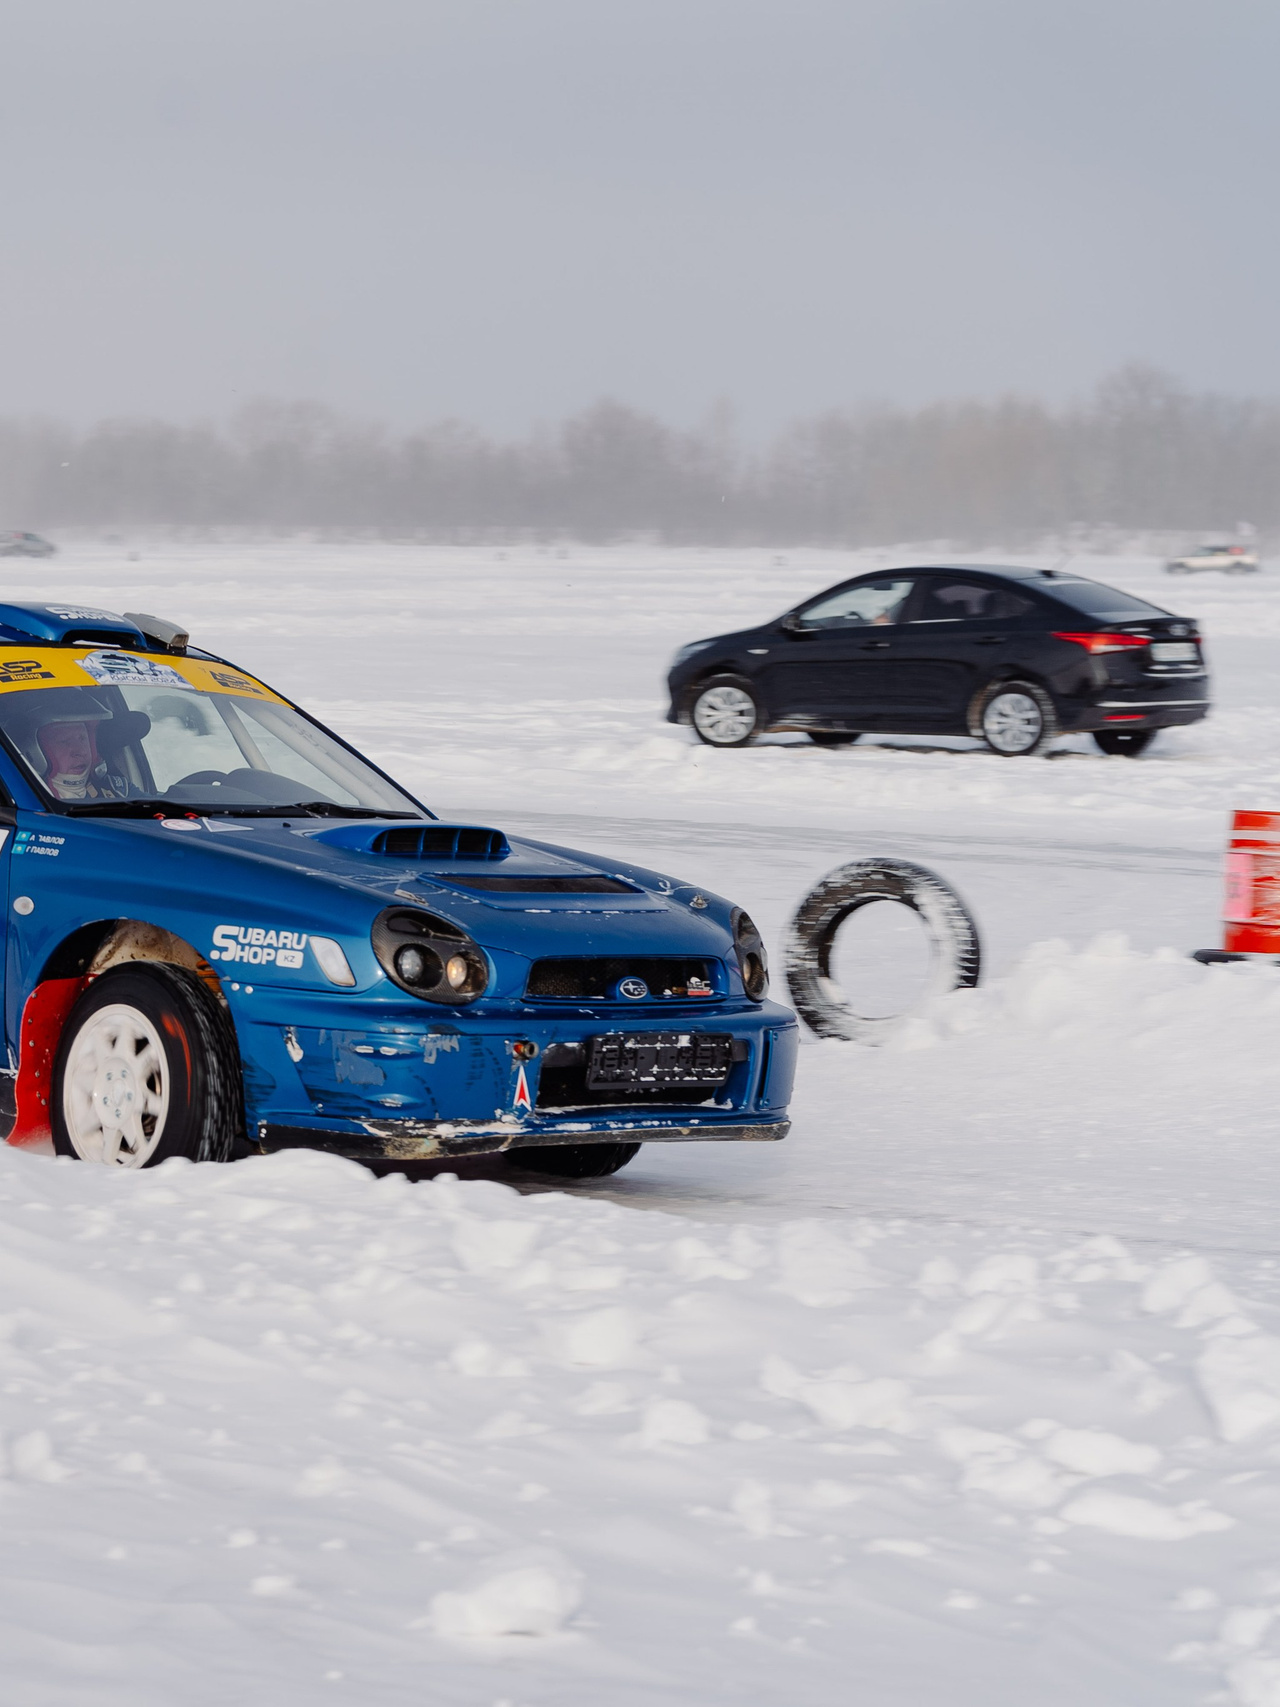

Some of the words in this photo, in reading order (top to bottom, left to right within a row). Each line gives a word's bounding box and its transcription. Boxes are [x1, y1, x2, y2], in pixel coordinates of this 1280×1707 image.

[10, 672, 42, 681] Racing
[212, 925, 307, 960] SUBARU
[283, 954, 295, 963] KZ
